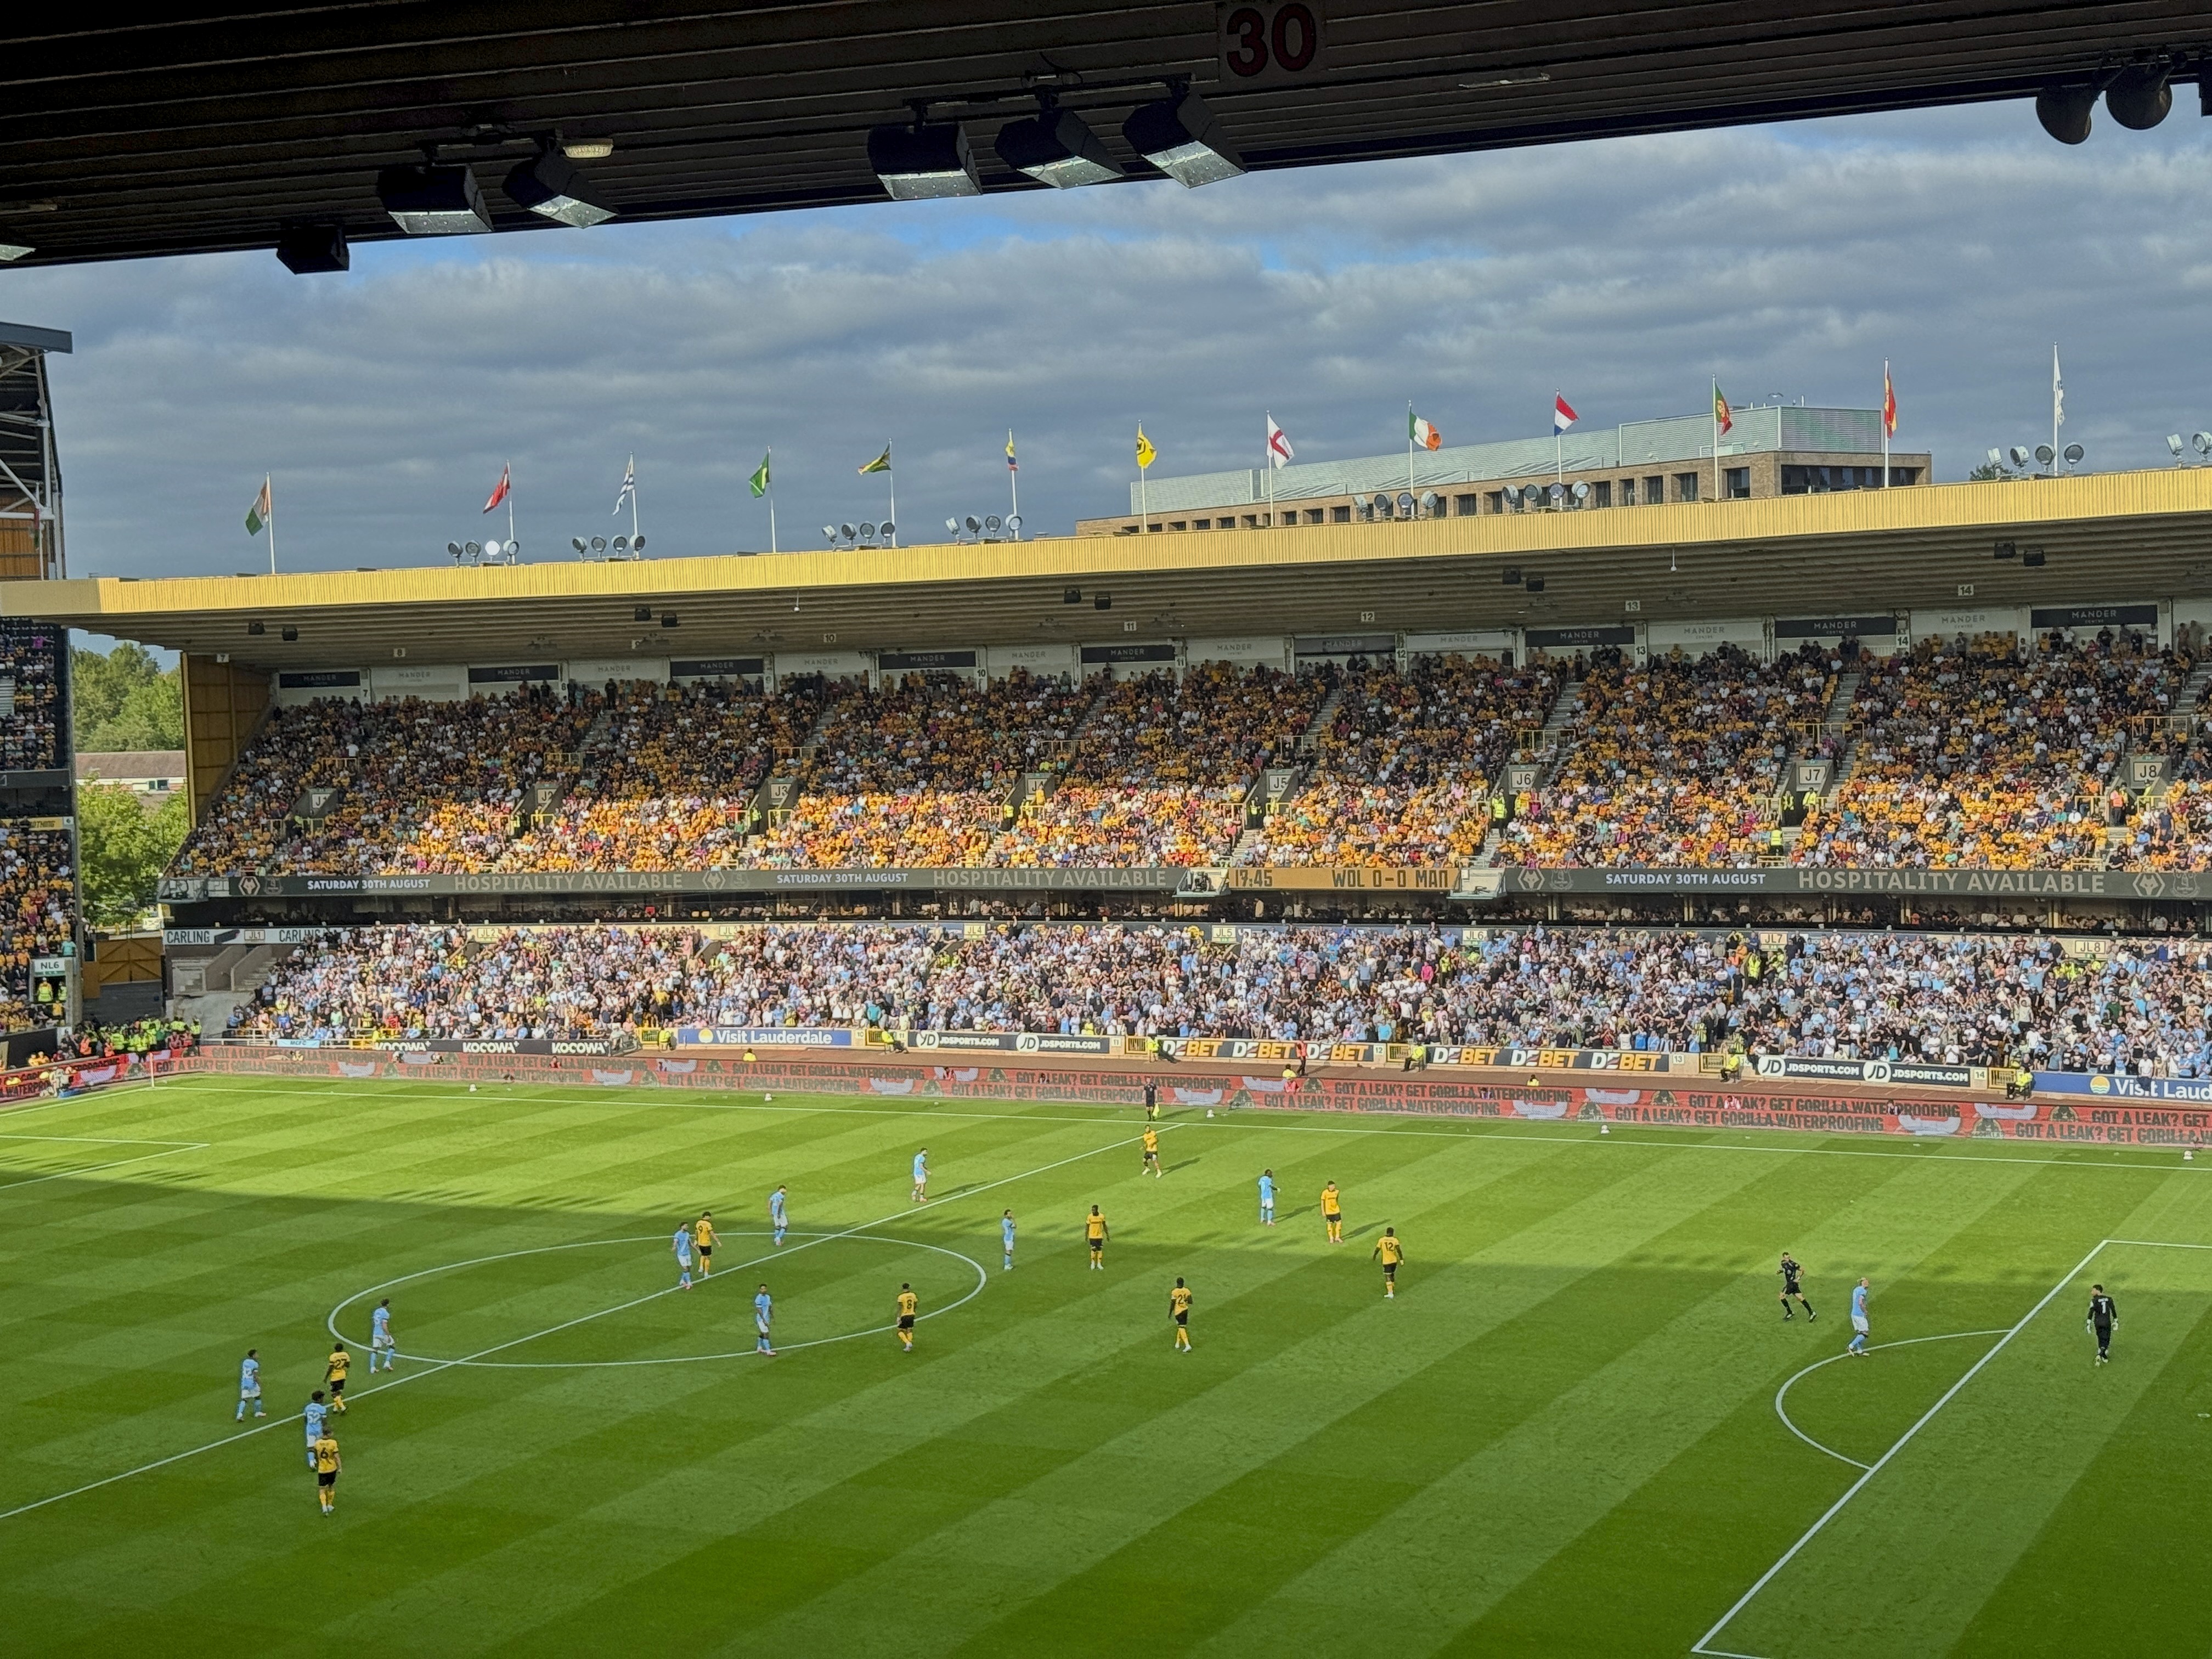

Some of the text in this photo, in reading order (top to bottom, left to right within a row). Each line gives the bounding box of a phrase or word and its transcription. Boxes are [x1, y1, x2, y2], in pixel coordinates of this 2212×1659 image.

[1226, 3, 1316, 77] 30
[1960, 586, 1972, 595] 14
[1941, 614, 1985, 624] MANDER
[2072, 610, 2117, 619] MANDER
[1814, 621, 1857, 629] MANDER
[1560, 631, 1600, 639] MANDER
[1898, 636, 1909, 646] 14
[1636, 646, 1646, 654] 13
[1805, 769, 1820, 781] J7
[2140, 765, 2157, 778] J8
[1274, 777, 1287, 788] J5
[1517, 774, 1531, 785] J6
[541, 791, 554, 801] J2
[775, 786, 788, 796] J3
[455, 874, 683, 891] HOSPITALITY AVAILABLE
[777, 873, 909, 884] SATURDAY 30TH AUGUST
[934, 870, 1166, 886] HOSPITALITY AVAILABLE
[1235, 869, 1273, 888] 17:45
[1332, 869, 1365, 888] WOL
[1415, 870, 1448, 888] MAN
[1606, 873, 1766, 884] SATURDAY 30TH AUGUST
[1799, 871, 2104, 893] HOSPITALITY AVAILABLE
[307, 879, 431, 890] SATURDAY 30TH AUGUST
[250, 931, 261, 939] JL1
[482, 928, 495, 938] JL2
[968, 925, 982, 934] JL4
[1216, 928, 1232, 937] JL5
[167, 930, 210, 943] CARLING
[1466, 931, 1483, 940] JL6
[1764, 934, 1783, 944] JL7
[2080, 942, 2101, 952] JL8
[41, 961, 59, 970] NL6
[716, 1030, 833, 1045] Visit Lauderdale
[921, 1034, 1000, 1047] JD JDSPORTS.COM
[1020, 1037, 1101, 1050] JD JDSPORTS.COM
[1762, 1059, 1782, 1074] JD
[1787, 1063, 1860, 1075] JDSPORTS.COM
[1867, 1065, 1968, 1082] JD JDSPORTS.COM
[1080, 1073, 1098, 1086] GET
[1015, 1086, 1032, 1098] GET
[1335, 1082, 1356, 1094] GOT
[1359, 1084, 1367, 1096] A
[1369, 1084, 1403, 1097] LEAK?
[1406, 1085, 1426, 1097] GET
[1264, 1093, 1285, 1107] GOT
[1289, 1095, 1295, 1107] A
[1298, 1095, 1331, 1109] LEAK?
[1334, 1096, 1355, 1110] GET
[1406, 1099, 1500, 1115] WATERPROOFING
[1689, 1094, 1713, 1108] GOT
[1716, 1095, 1724, 1108] A
[1769, 1098, 1794, 1111] GET
[1796, 1098, 1849, 1114] GORILLA
[1852, 1101, 1960, 1117] WATEPROOFING
[1615, 1107, 1639, 1121] GOT
[1642, 1108, 1651, 1122] A
[1654, 1108, 1691, 1123] LEAK?
[1695, 1110, 1718, 1124] GET
[1720, 1110, 1772, 1126] GORILLA
[1776, 1113, 1883, 1131] WATERPROOFING
[2092, 1110, 2209, 1127] GOT A LEAK? GET
[2015, 1122, 2042, 1137] GOT
[2046, 1124, 2057, 1138] A
[2059, 1125, 2103, 1141] LEAK?
[2107, 1126, 2134, 1142] GET
[698, 1225, 703, 1233] 9
[1384, 1242, 1393, 1251] 12
[907, 1299, 912, 1310] 8
[2101, 1301, 2107, 1314] 1
[320, 1447, 328, 1459] 6
